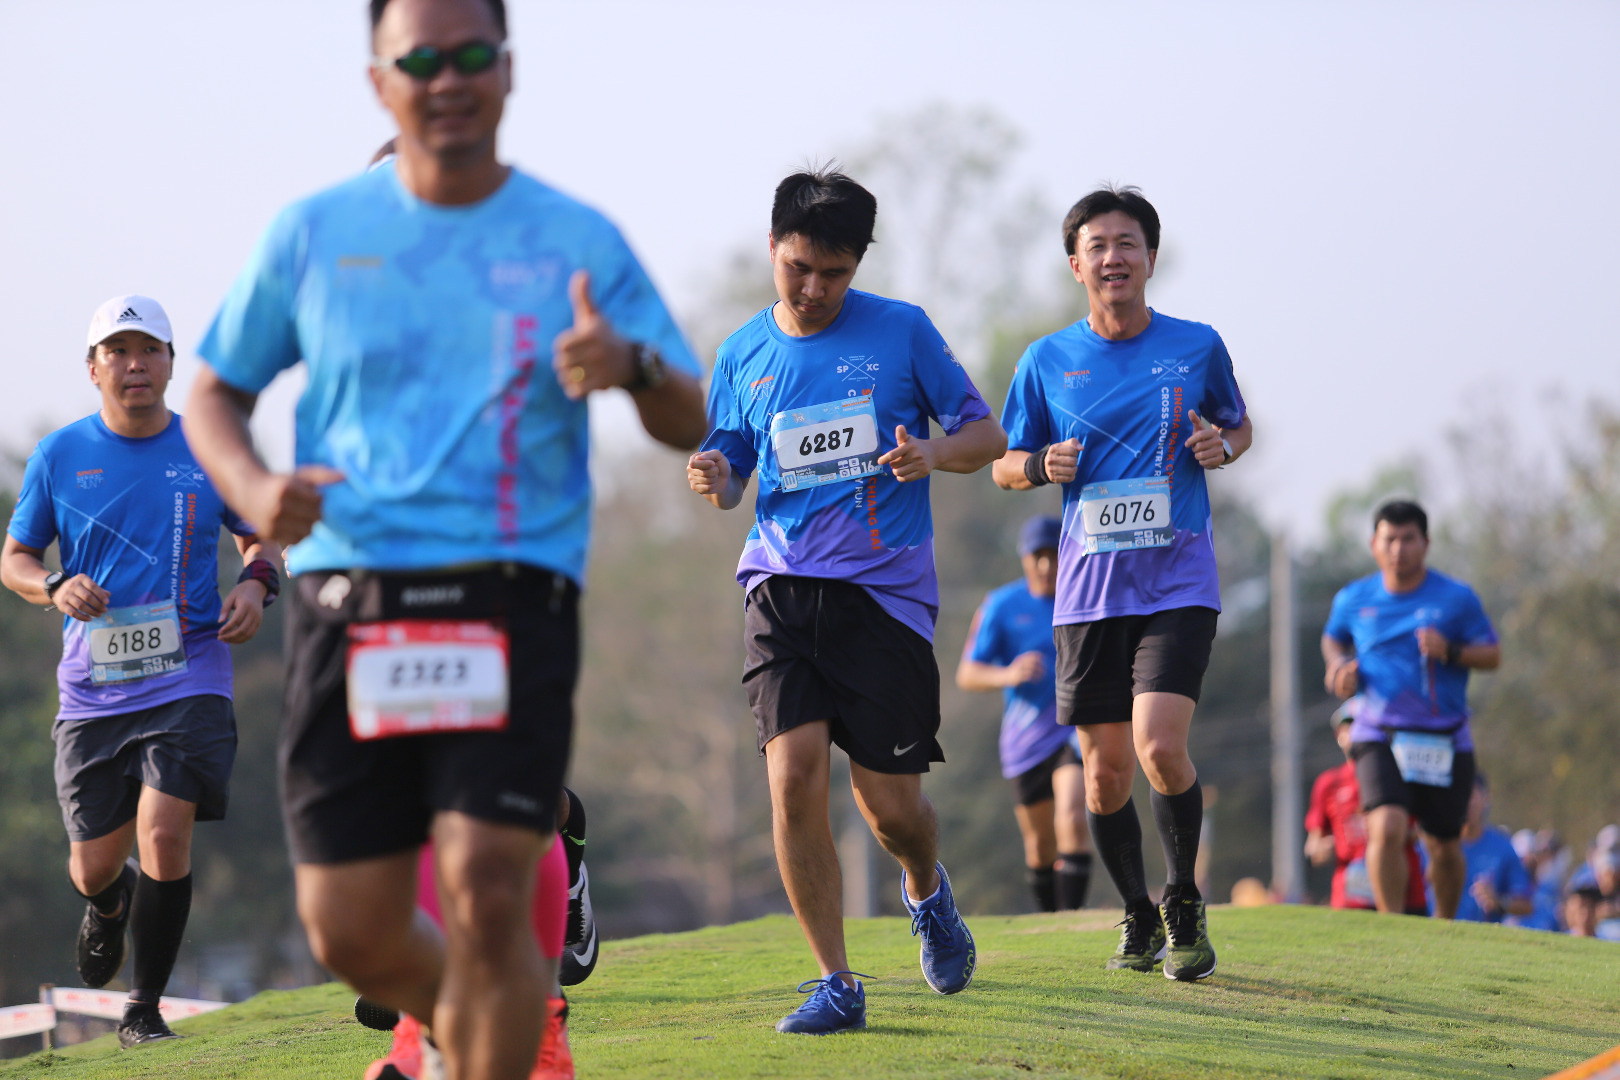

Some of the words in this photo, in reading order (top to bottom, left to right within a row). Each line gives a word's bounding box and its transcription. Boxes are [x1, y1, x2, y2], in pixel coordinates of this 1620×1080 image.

[837, 366, 849, 374] SP
[866, 363, 879, 371] XC
[1151, 367, 1163, 375] SP
[1161, 387, 1169, 419] CROSS
[1172, 386, 1183, 429] SINGHA
[800, 427, 854, 456] 6287
[1154, 421, 1169, 469] COUNTRY
[1166, 432, 1178, 461] PARK
[174, 491, 183, 526] CROSS
[854, 486, 863, 508] RUN
[867, 477, 878, 526] CHIANG
[186, 493, 197, 536] SINGHA
[1100, 500, 1155, 526] 6076
[171, 527, 182, 576] COUNTRY
[181, 539, 192, 569] PARK
[869, 529, 881, 550] RAI
[108, 627, 161, 655] 6188
